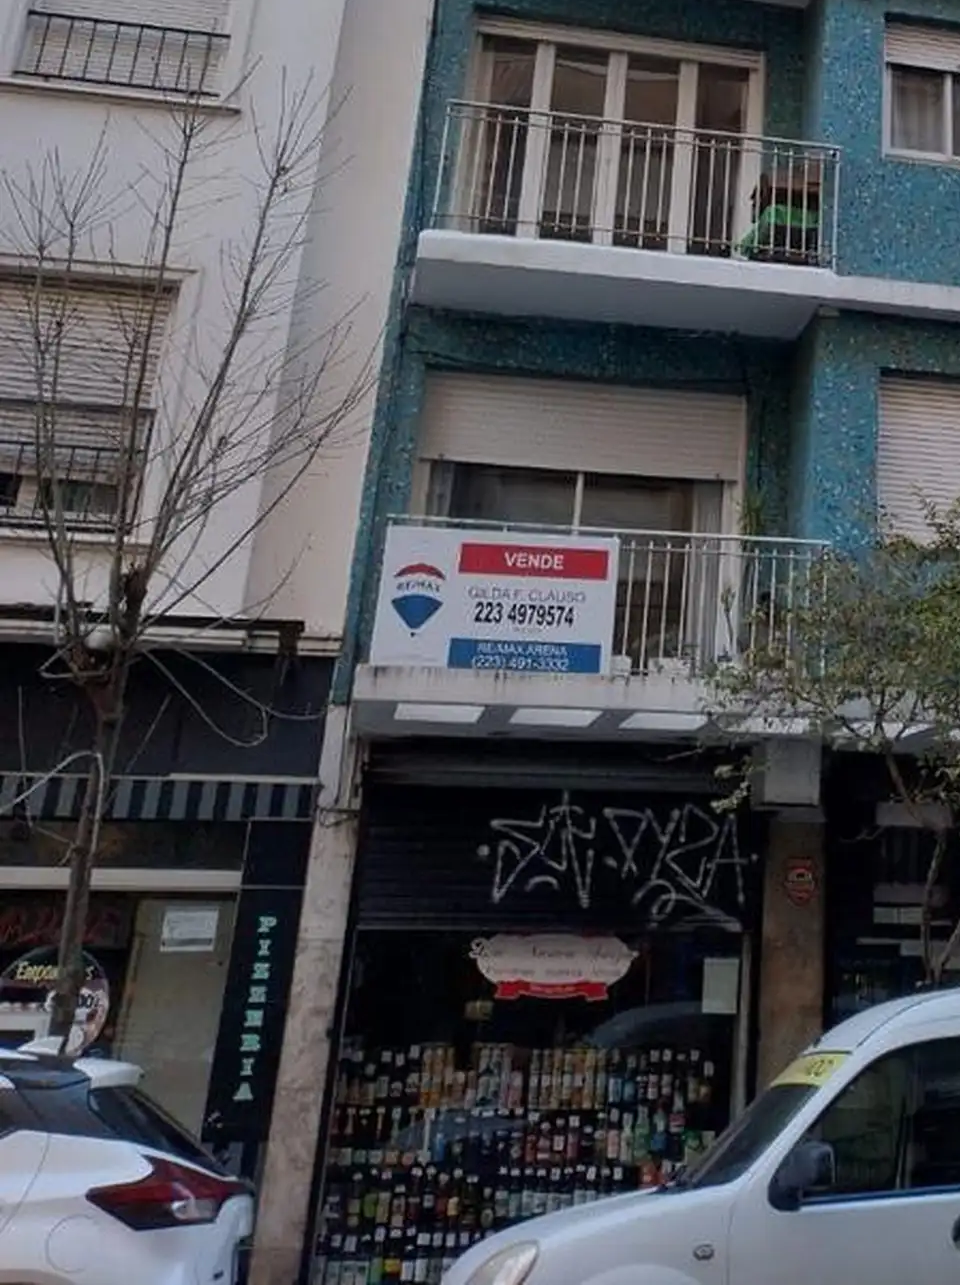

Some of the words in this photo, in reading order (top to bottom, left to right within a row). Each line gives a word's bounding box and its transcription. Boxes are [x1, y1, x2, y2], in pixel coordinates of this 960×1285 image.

[503, 551, 565, 570] VENDE
[474, 601, 504, 624] 223
[507, 603, 575, 628] 4979574
[231, 915, 278, 1102] PIZZERIA
